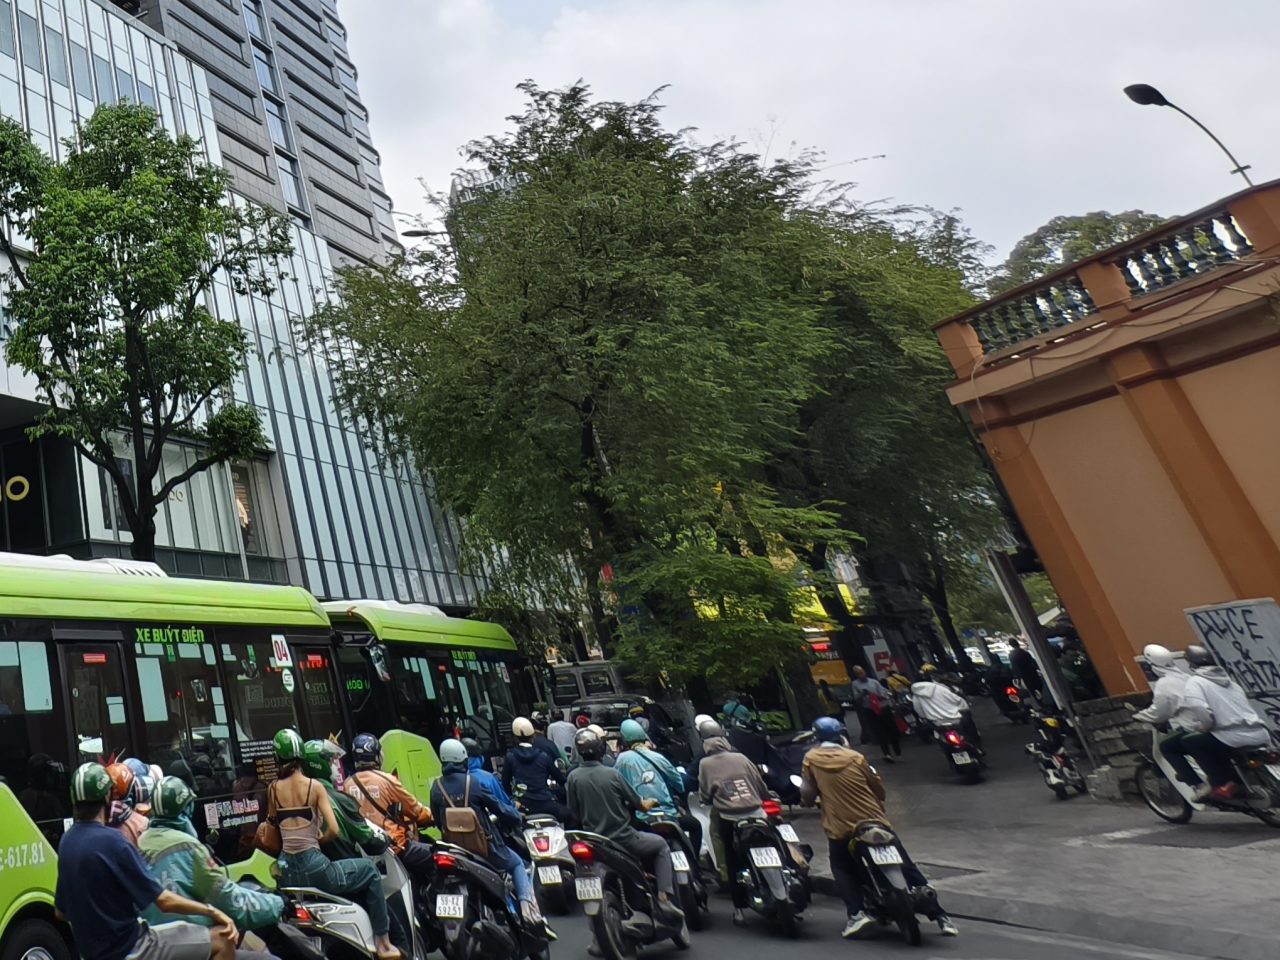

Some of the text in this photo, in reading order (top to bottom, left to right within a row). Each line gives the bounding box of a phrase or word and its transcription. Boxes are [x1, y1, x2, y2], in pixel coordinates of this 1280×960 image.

[136, 628, 151, 642] XE
[152, 624, 180, 642] BUÝT
[274, 640, 289, 662] 04
